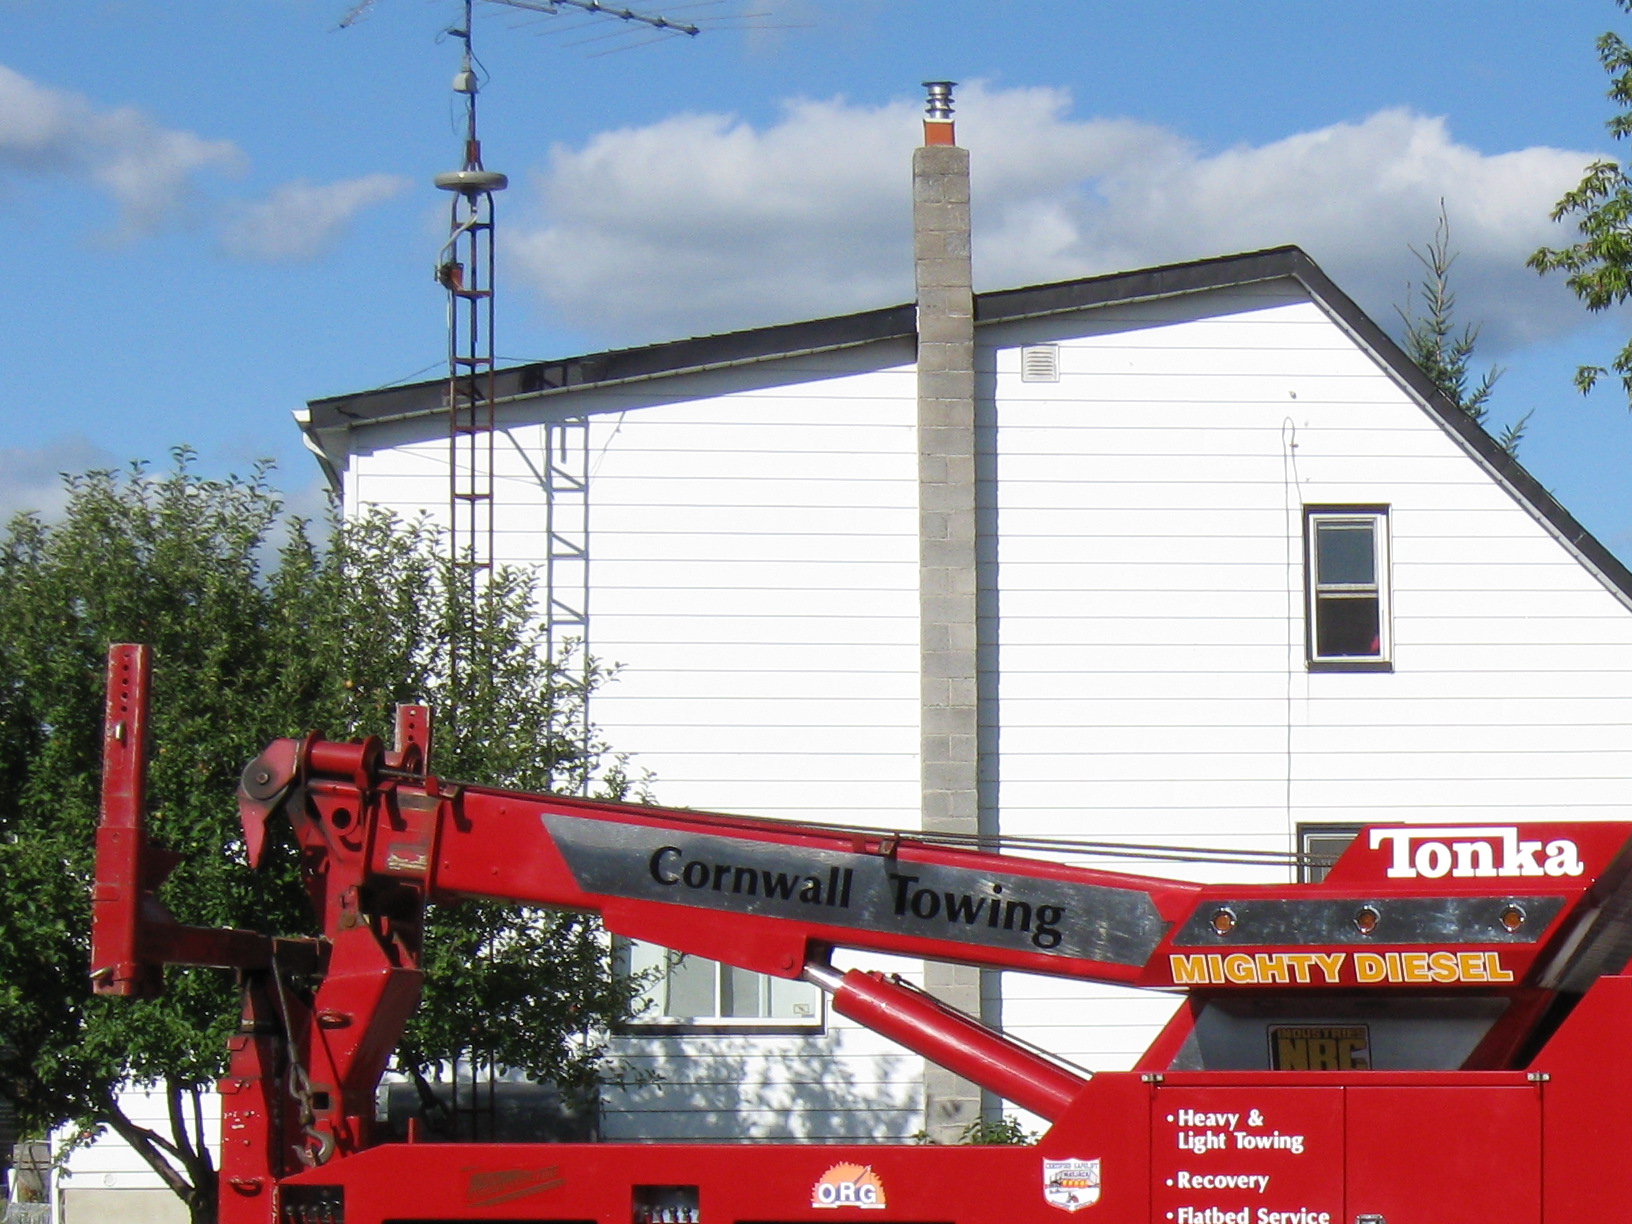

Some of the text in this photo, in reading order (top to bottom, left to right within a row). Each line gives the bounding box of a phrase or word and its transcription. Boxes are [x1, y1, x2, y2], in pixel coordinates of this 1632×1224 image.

[1369, 827, 1584, 878] Tonka
[649, 846, 1066, 948] Cornwall Towing
[1169, 951, 1514, 984] MIGHTY DIESEL
[1277, 1027, 1366, 1039] INDUSTRIES
[1278, 1039, 1369, 1071] NRC
[1178, 1109, 1264, 1131] Heavy &
[1178, 1130, 1304, 1154] Light Towing
[818, 1182, 877, 1204] ORG
[1177, 1171, 1270, 1193] Recovery
